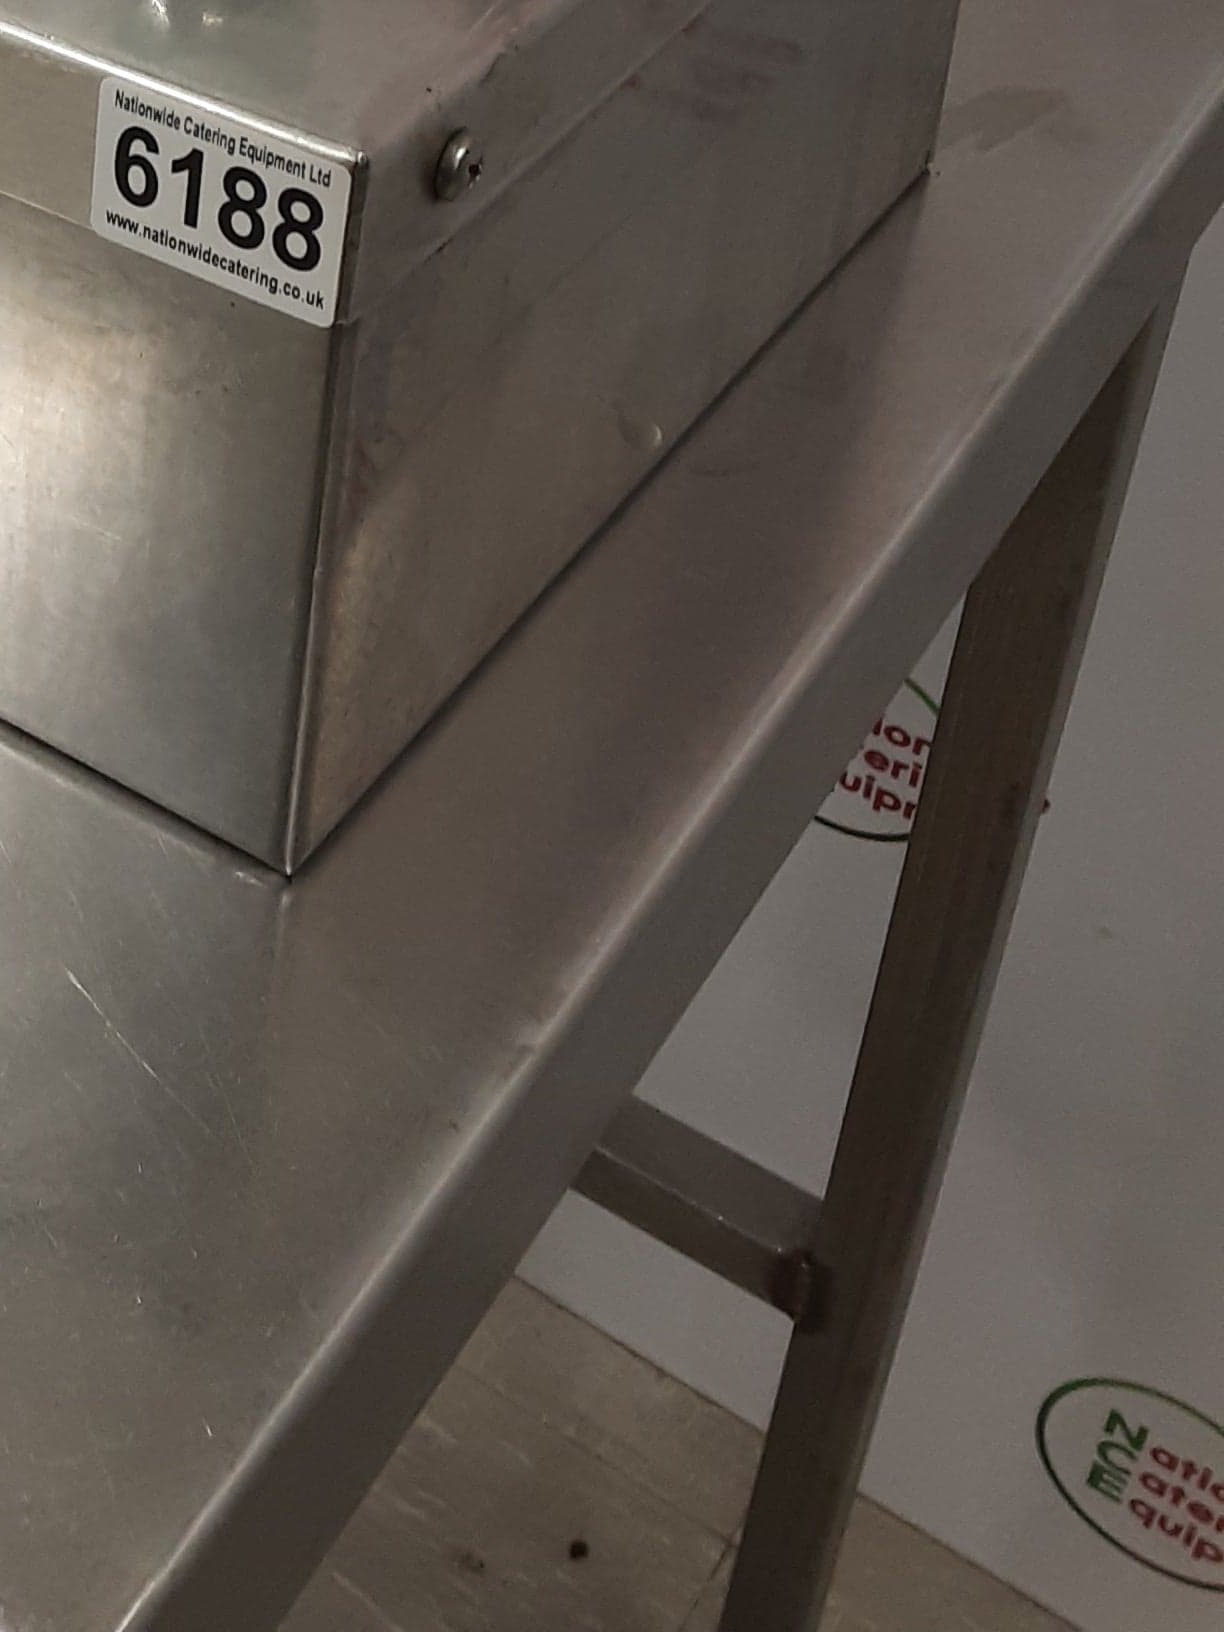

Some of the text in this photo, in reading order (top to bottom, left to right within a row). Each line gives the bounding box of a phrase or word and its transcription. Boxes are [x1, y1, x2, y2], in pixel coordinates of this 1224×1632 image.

[114, 89, 332, 188] Nationwide Catering Equipment Ltd
[114, 125, 324, 272] 6188
[105, 210, 325, 311] www.nationwidecatering.co.uk
